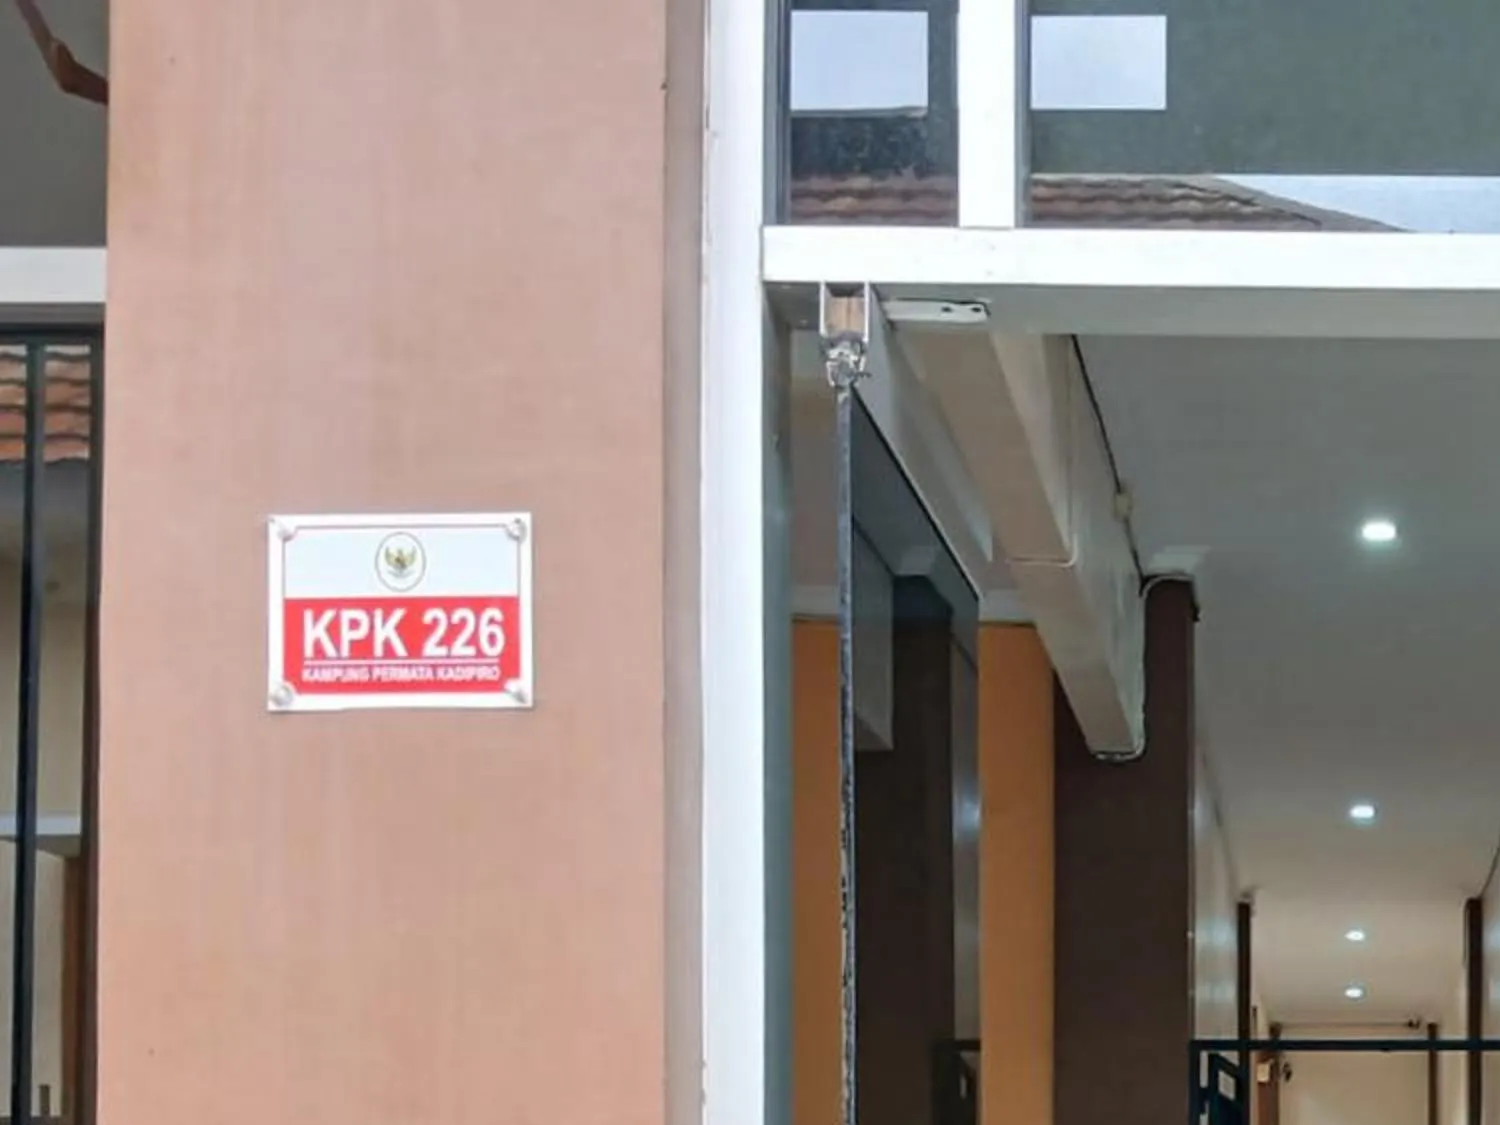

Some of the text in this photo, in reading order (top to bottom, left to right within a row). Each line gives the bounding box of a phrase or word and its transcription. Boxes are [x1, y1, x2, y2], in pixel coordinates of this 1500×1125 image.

[304, 607, 505, 658] KPK 226
[303, 666, 369, 682] KAMPUNG
[373, 666, 432, 682] PERMATA
